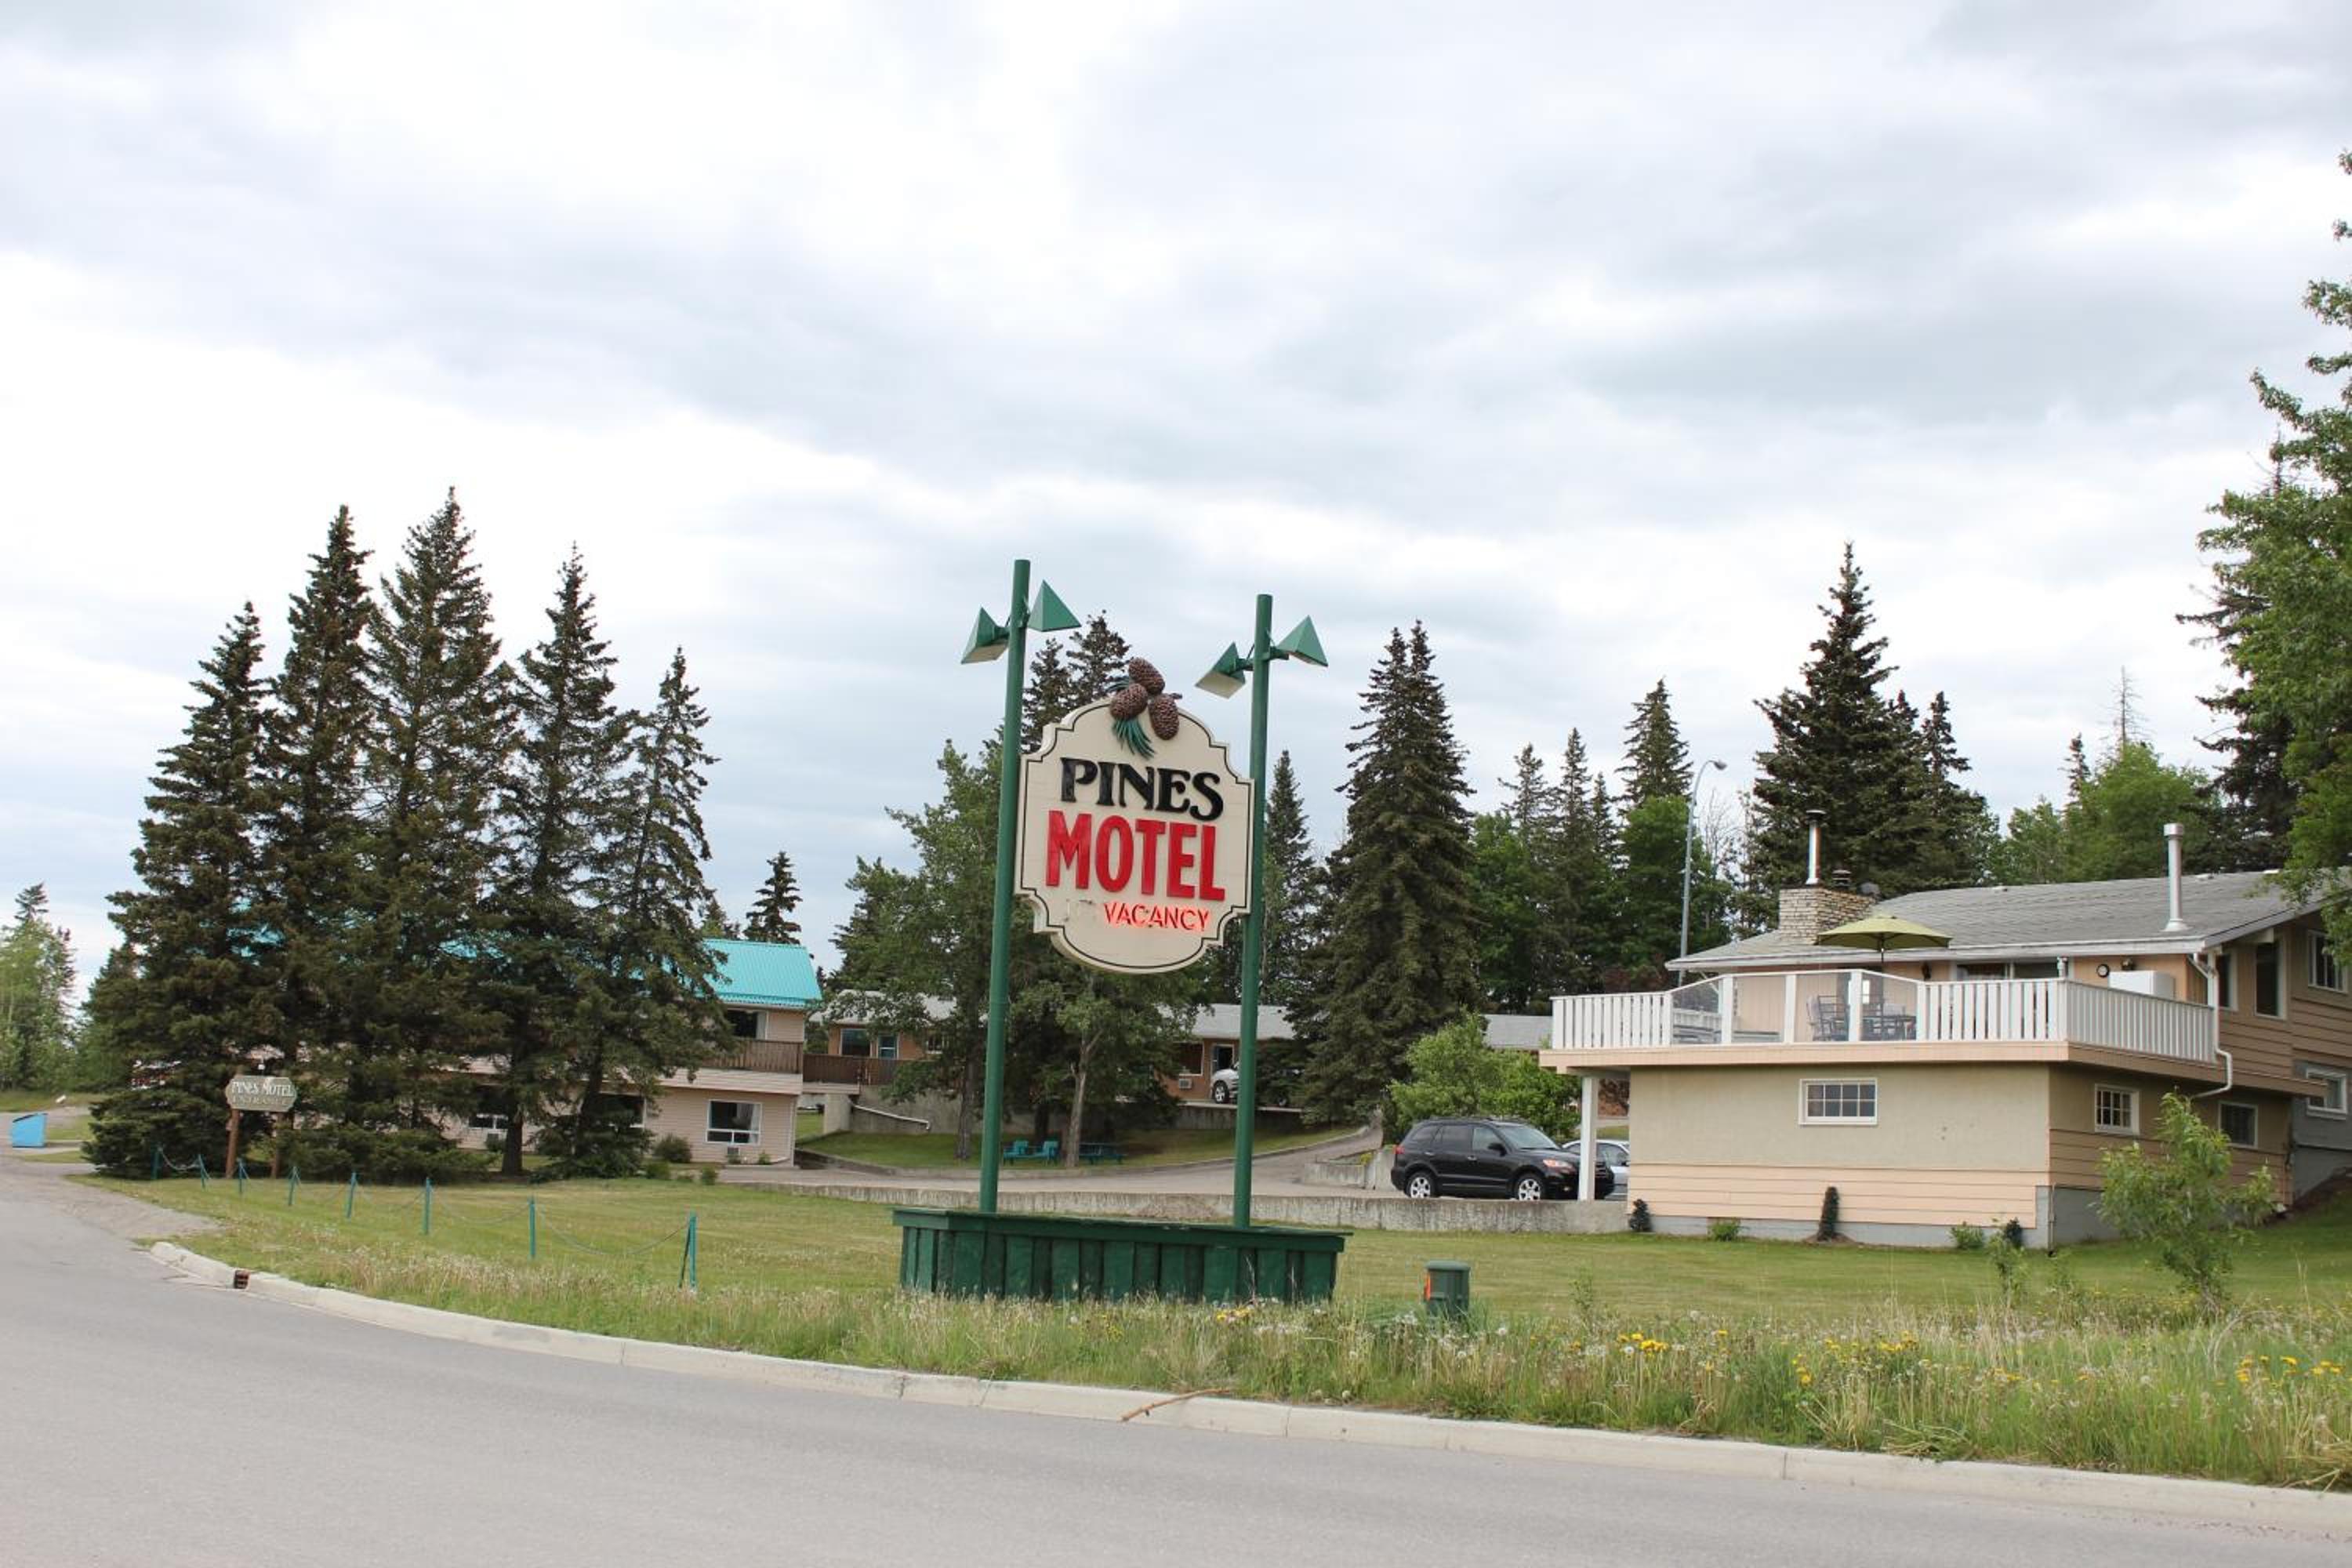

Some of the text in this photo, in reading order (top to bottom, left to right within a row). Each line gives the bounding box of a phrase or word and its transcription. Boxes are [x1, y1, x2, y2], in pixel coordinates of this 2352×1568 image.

[1060, 757, 1224, 822] PINES
[1046, 810, 1225, 902] MOTEL
[1104, 902, 1209, 931] VACANCY
[231, 1081, 294, 1097] PINES MOTEL
